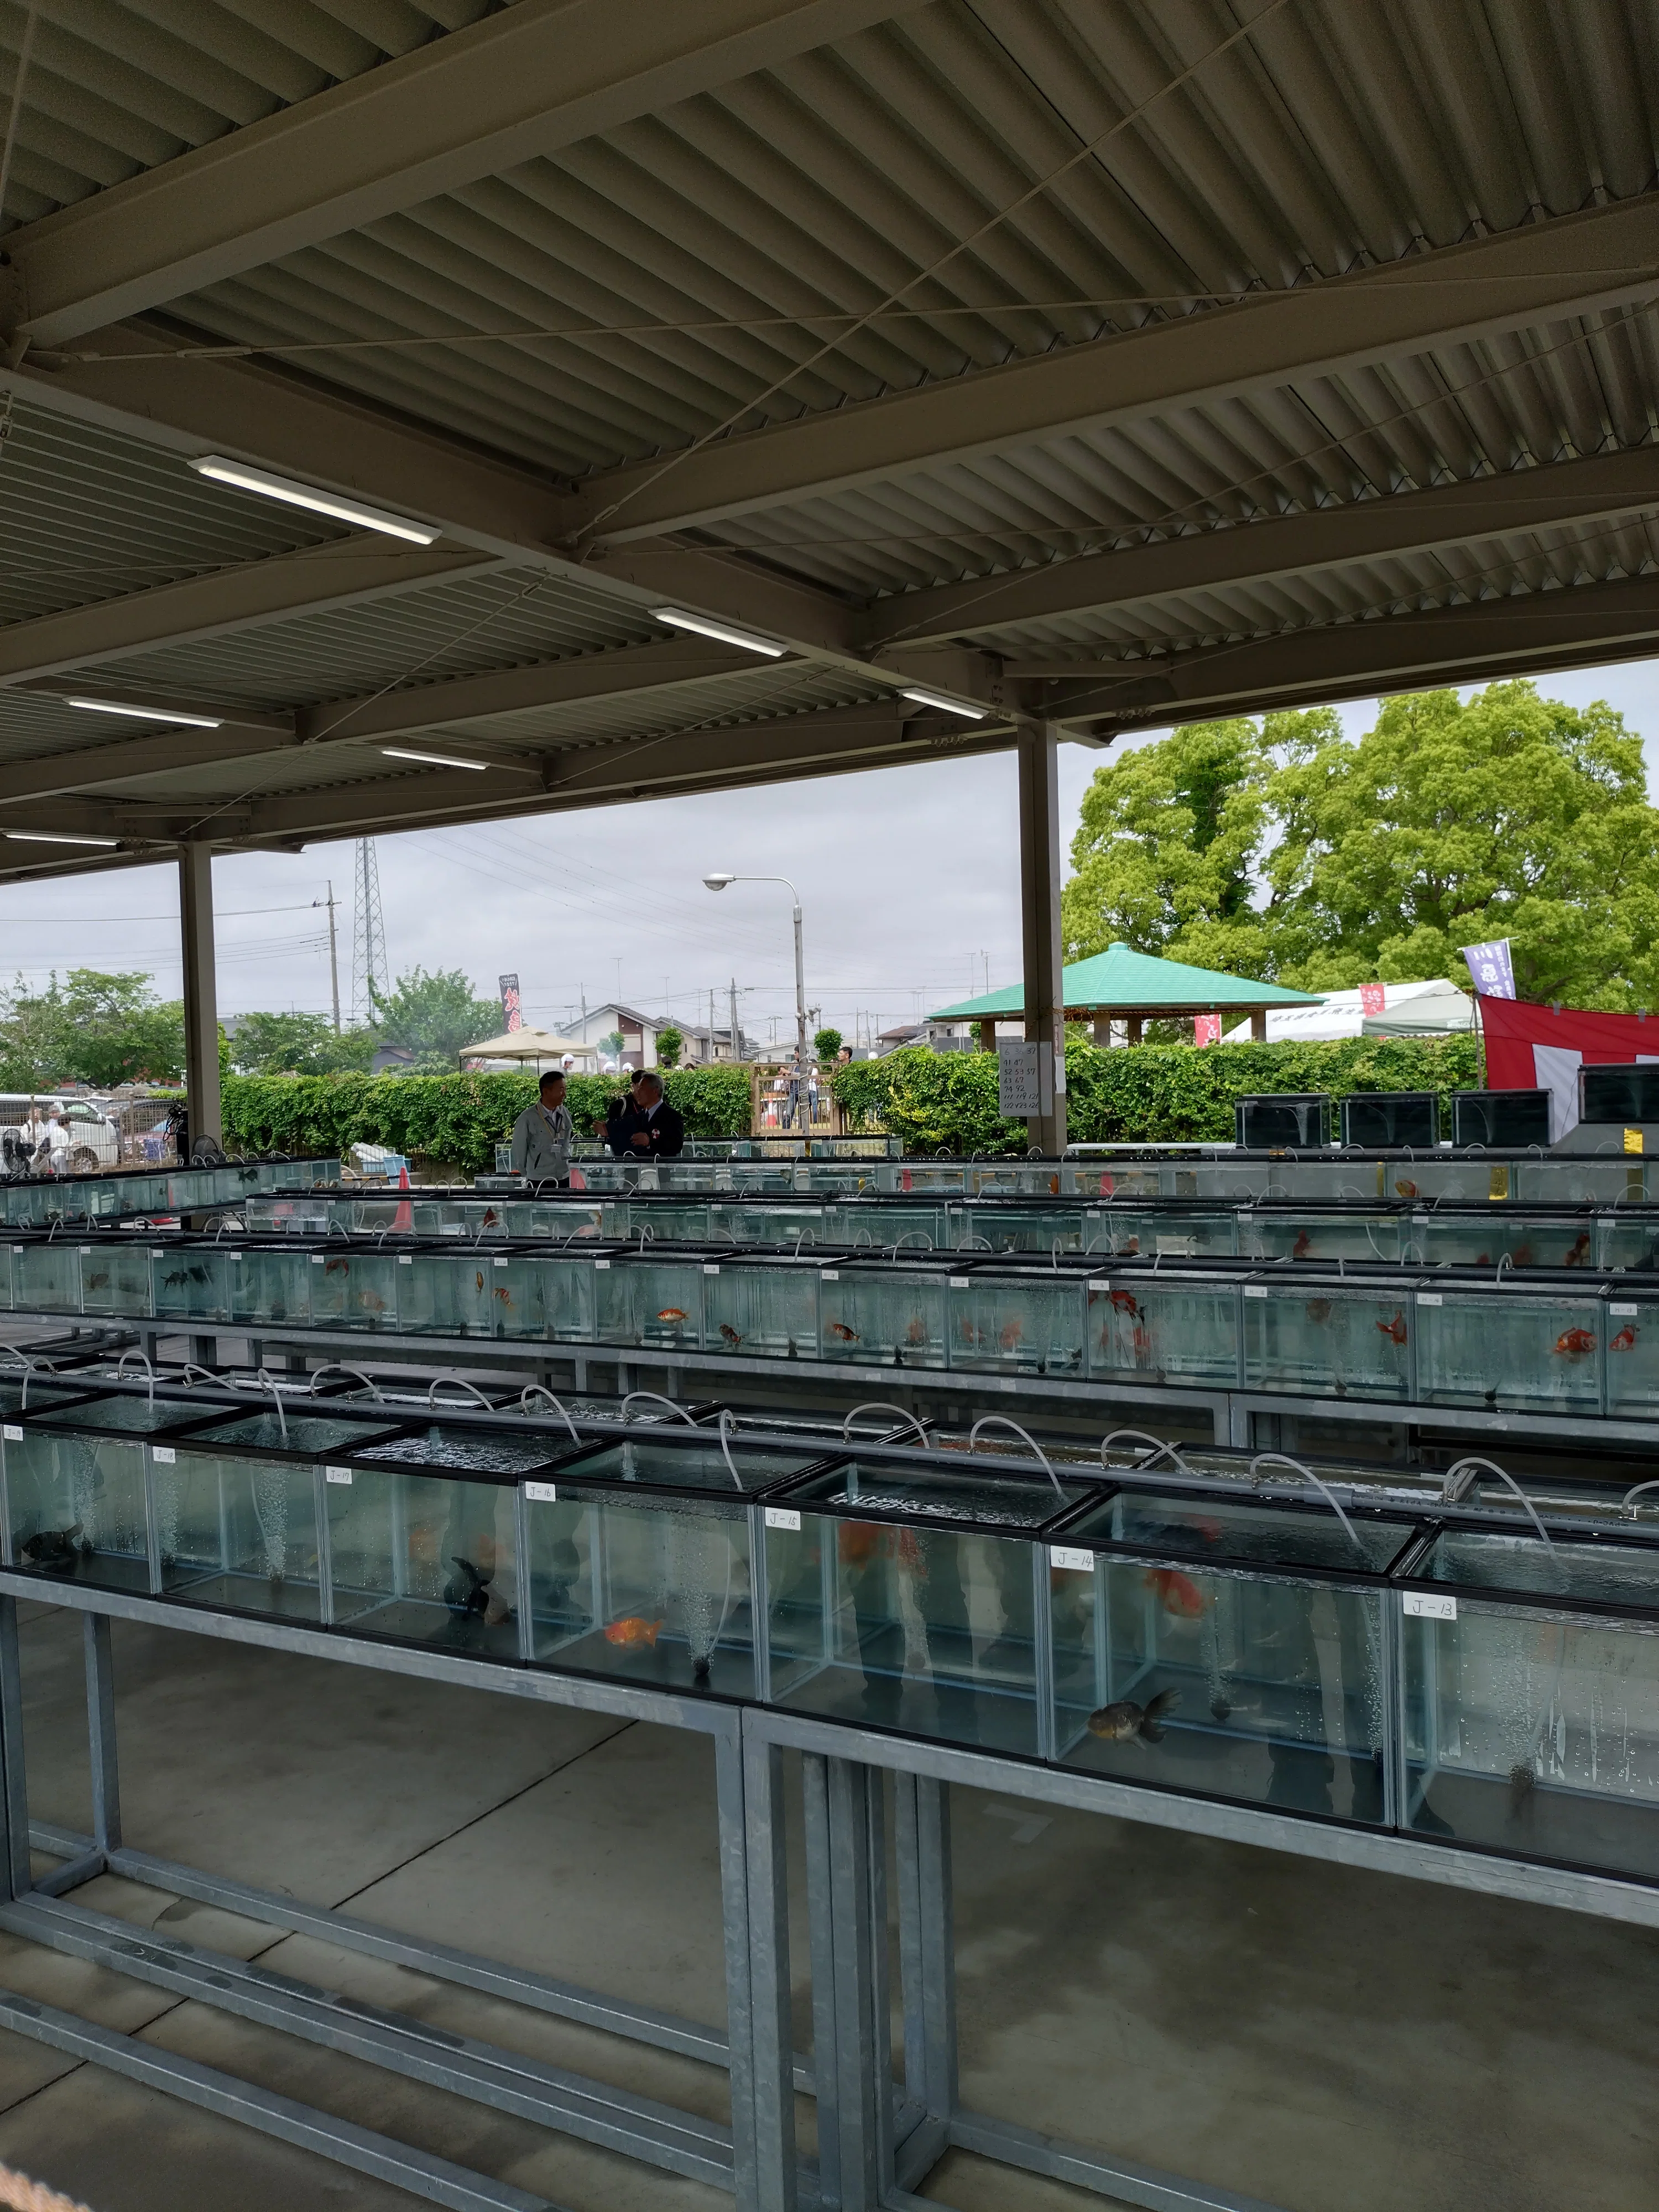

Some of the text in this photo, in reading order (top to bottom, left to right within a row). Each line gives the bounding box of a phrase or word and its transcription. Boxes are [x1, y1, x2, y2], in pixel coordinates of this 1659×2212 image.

[8, 1428, 21, 1438] J-19
[157, 1449, 173, 1460] J-18
[330, 1470, 349, 1481] J-17
[530, 1486, 551, 1498] J-16
[770, 1512, 797, 1525] J-15
[1058, 1552, 1093, 1567] J-14
[1412, 1600, 1452, 1616] J-13
